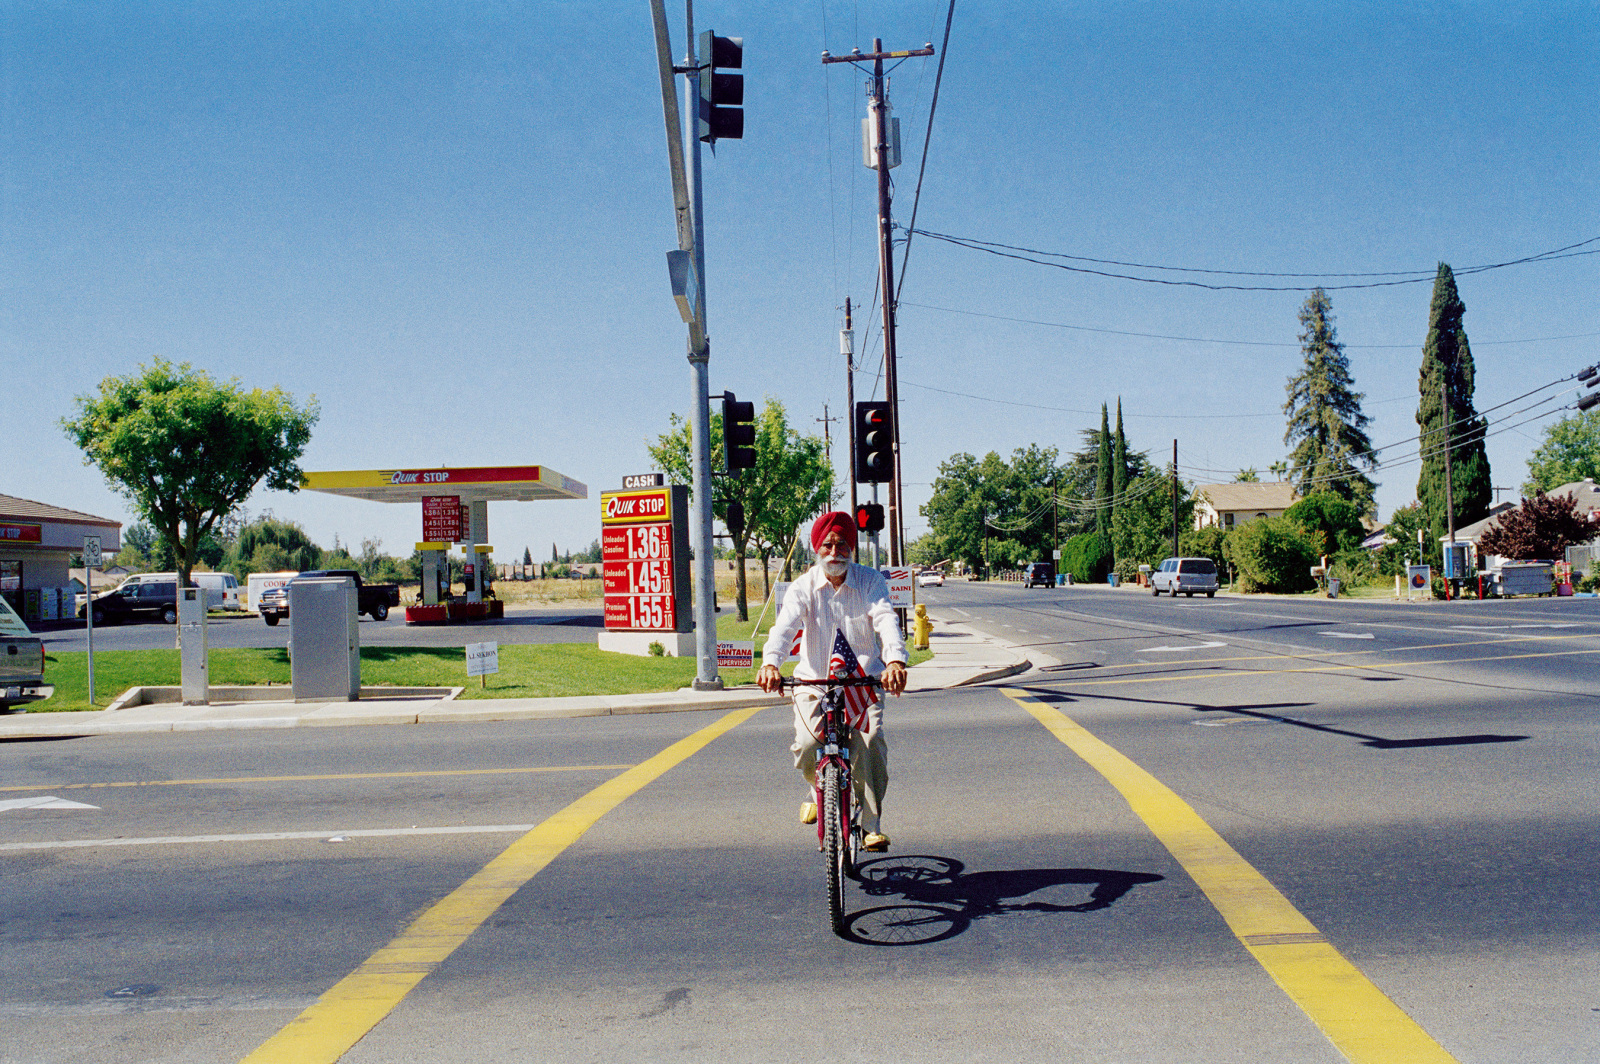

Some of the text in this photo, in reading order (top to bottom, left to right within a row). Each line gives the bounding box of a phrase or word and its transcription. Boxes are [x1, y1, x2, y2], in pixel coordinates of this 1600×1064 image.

[390, 471, 449, 484] QUIK STOP
[626, 475, 654, 488] CASH
[606, 497, 664, 518] QUIK STOP
[604, 536, 625, 544] Unleaded
[626, 527, 660, 559] 1.36
[604, 545, 624, 554] Gasoline
[605, 569, 626, 577] Unleaded
[627, 562, 661, 593] 1.45
[605, 580, 615, 588] Plus
[606, 603, 626, 611] Premium
[628, 596, 662, 628] 1.55
[606, 613, 628, 621] Unleaded
